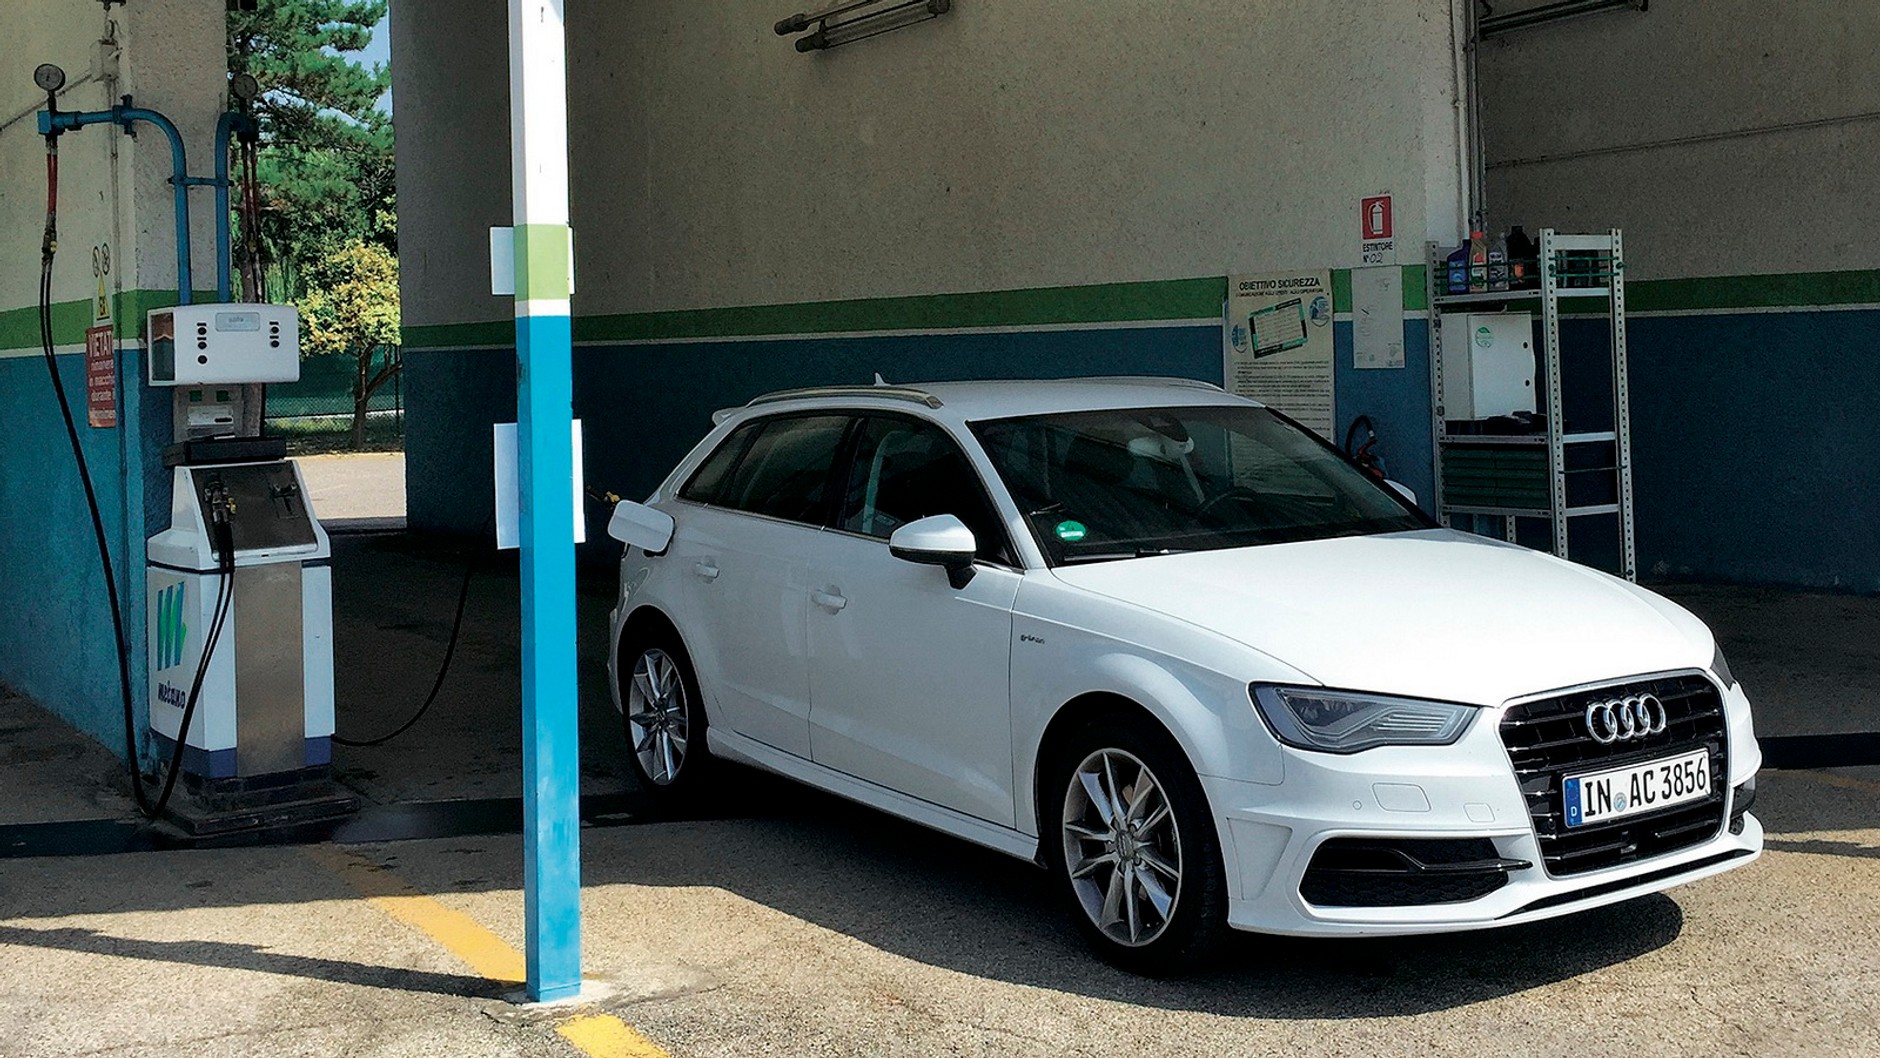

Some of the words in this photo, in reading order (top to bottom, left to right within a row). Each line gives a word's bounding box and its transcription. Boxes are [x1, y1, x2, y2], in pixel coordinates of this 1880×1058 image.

[1362, 241, 1394, 252] ESTINTORE
[1239, 280, 1276, 291] OBIETTIVO
[1278, 277, 1320, 289] SICUREZZA
[87, 330, 115, 358] VIETAT
[158, 680, 186, 710] metano
[1584, 778, 1612, 817] IN
[1629, 770, 1656, 808] AC
[1660, 757, 1706, 800] 3856
[1570, 806, 1577, 817] D
